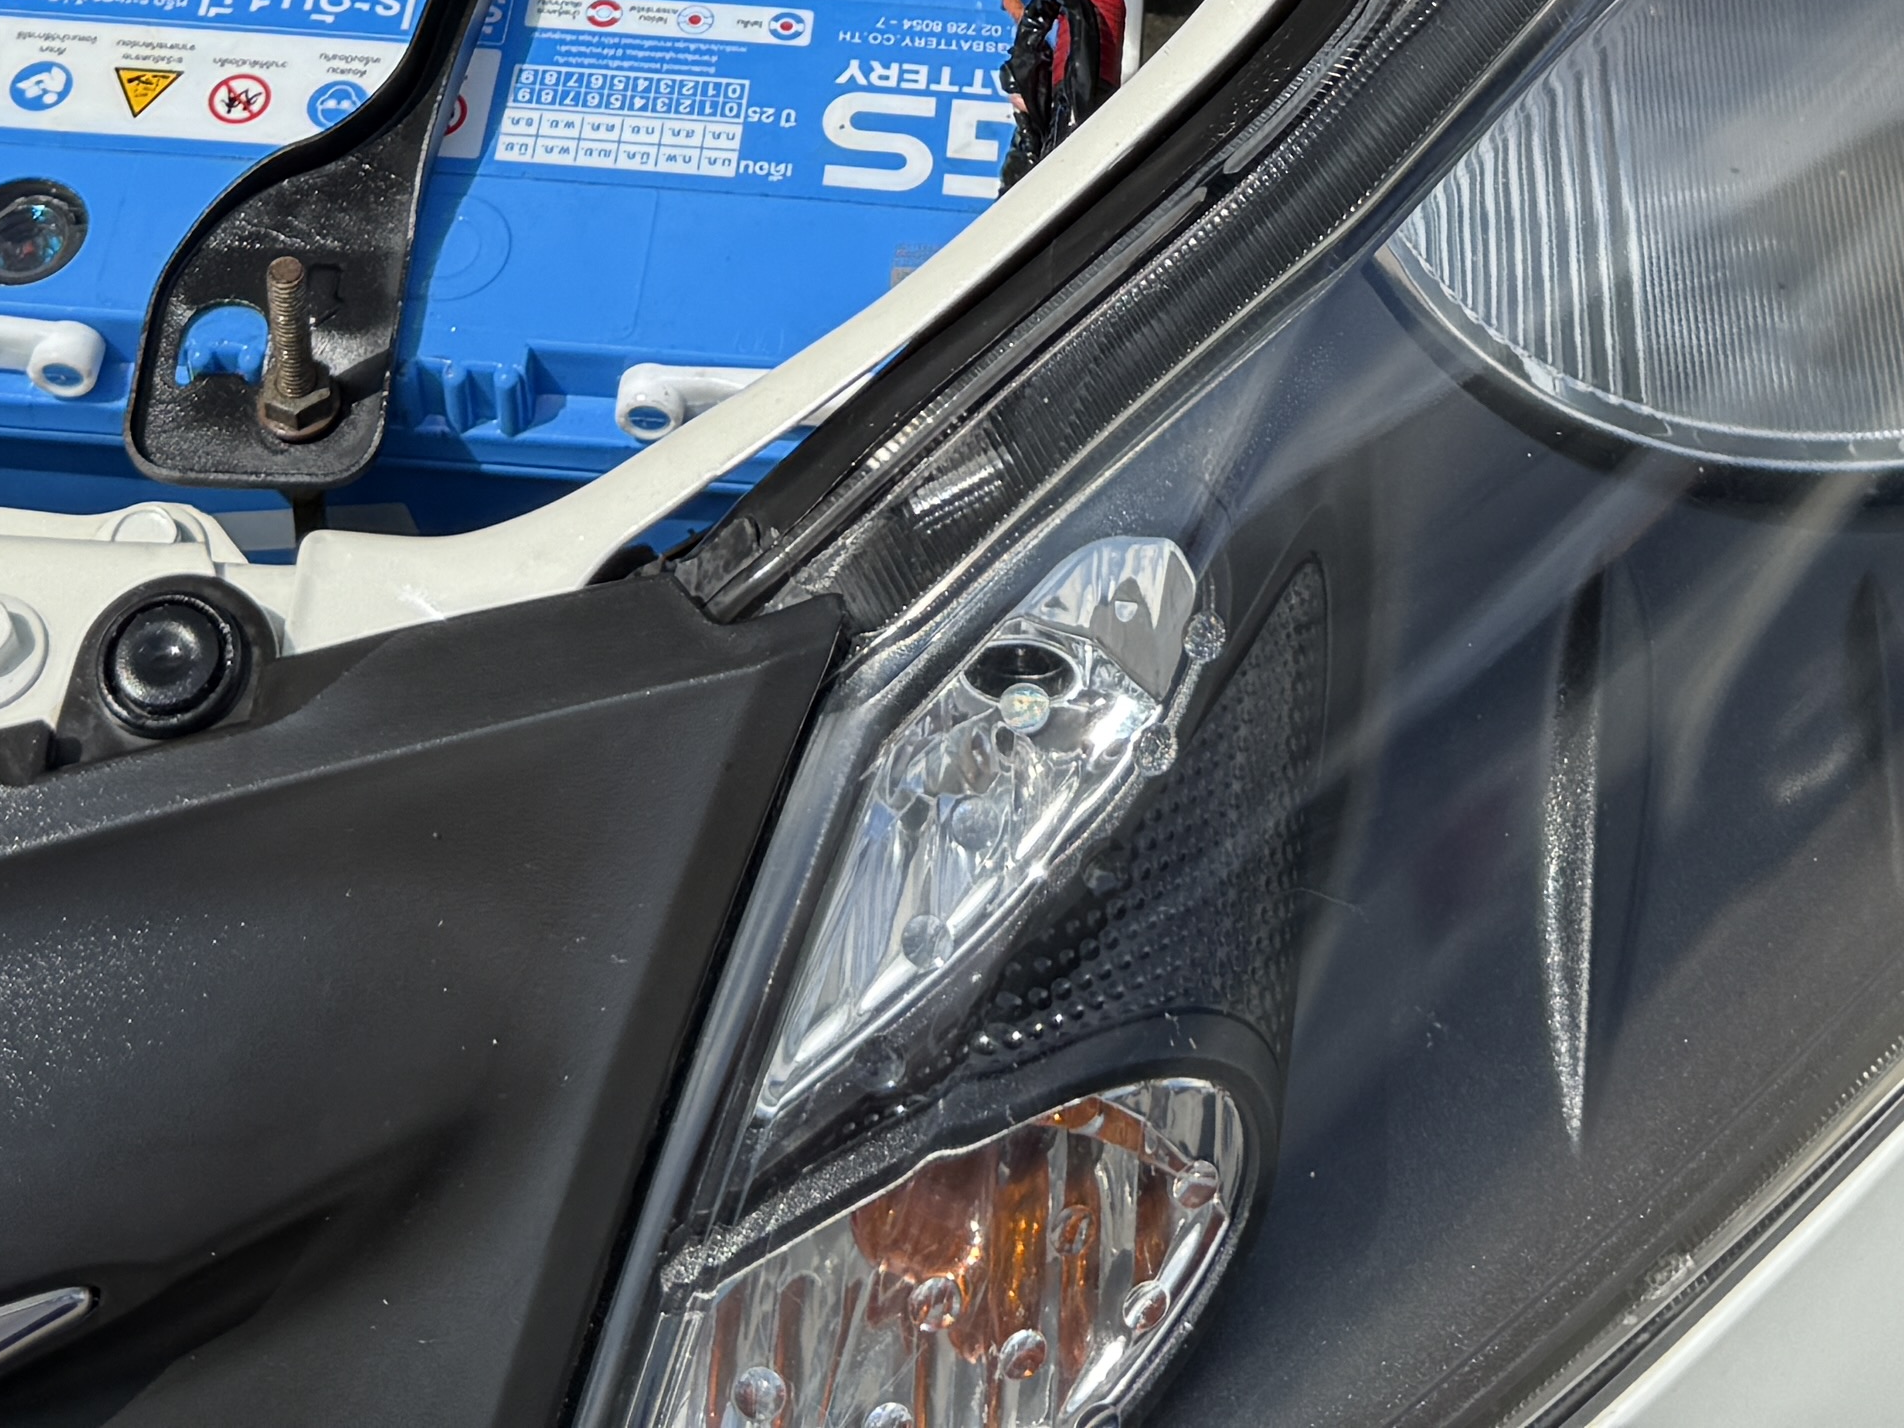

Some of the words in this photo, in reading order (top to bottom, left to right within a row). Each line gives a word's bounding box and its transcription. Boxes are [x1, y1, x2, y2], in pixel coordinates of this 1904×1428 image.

[875, 16, 886, 28] 7
[902, 18, 942, 33] 8054
[946, 22, 976, 36] 726
[981, 24, 1002, 37] 02
[522, 69, 535, 84] 9
[545, 70, 558, 85] 8
[569, 72, 579, 87] 7
[590, 74, 603, 89] 6
[613, 76, 627, 91] 5
[834, 58, 1003, 96] ATTERY
[636, 78, 649, 92] 4
[659, 79, 673, 94] 3
[682, 81, 696, 95] 2
[709, 82, 716, 97] 1
[728, 84, 741, 99] 0
[517, 87, 531, 102] 9
[541, 89, 554, 104] 8
[566, 91, 575, 106] 7
[587, 93, 600, 108] 6
[609, 94, 623, 110] 5
[633, 95, 646, 110] 4
[656, 97, 668, 111] 3
[678, 99, 691, 113] 2
[705, 100, 713, 115] 1
[726, 102, 738, 117] 0
[747, 106, 774, 122] 25
[780, 108, 796, 128] ปี
[822, 91, 1014, 200] GS
[740, 160, 792, 181] เดือน
